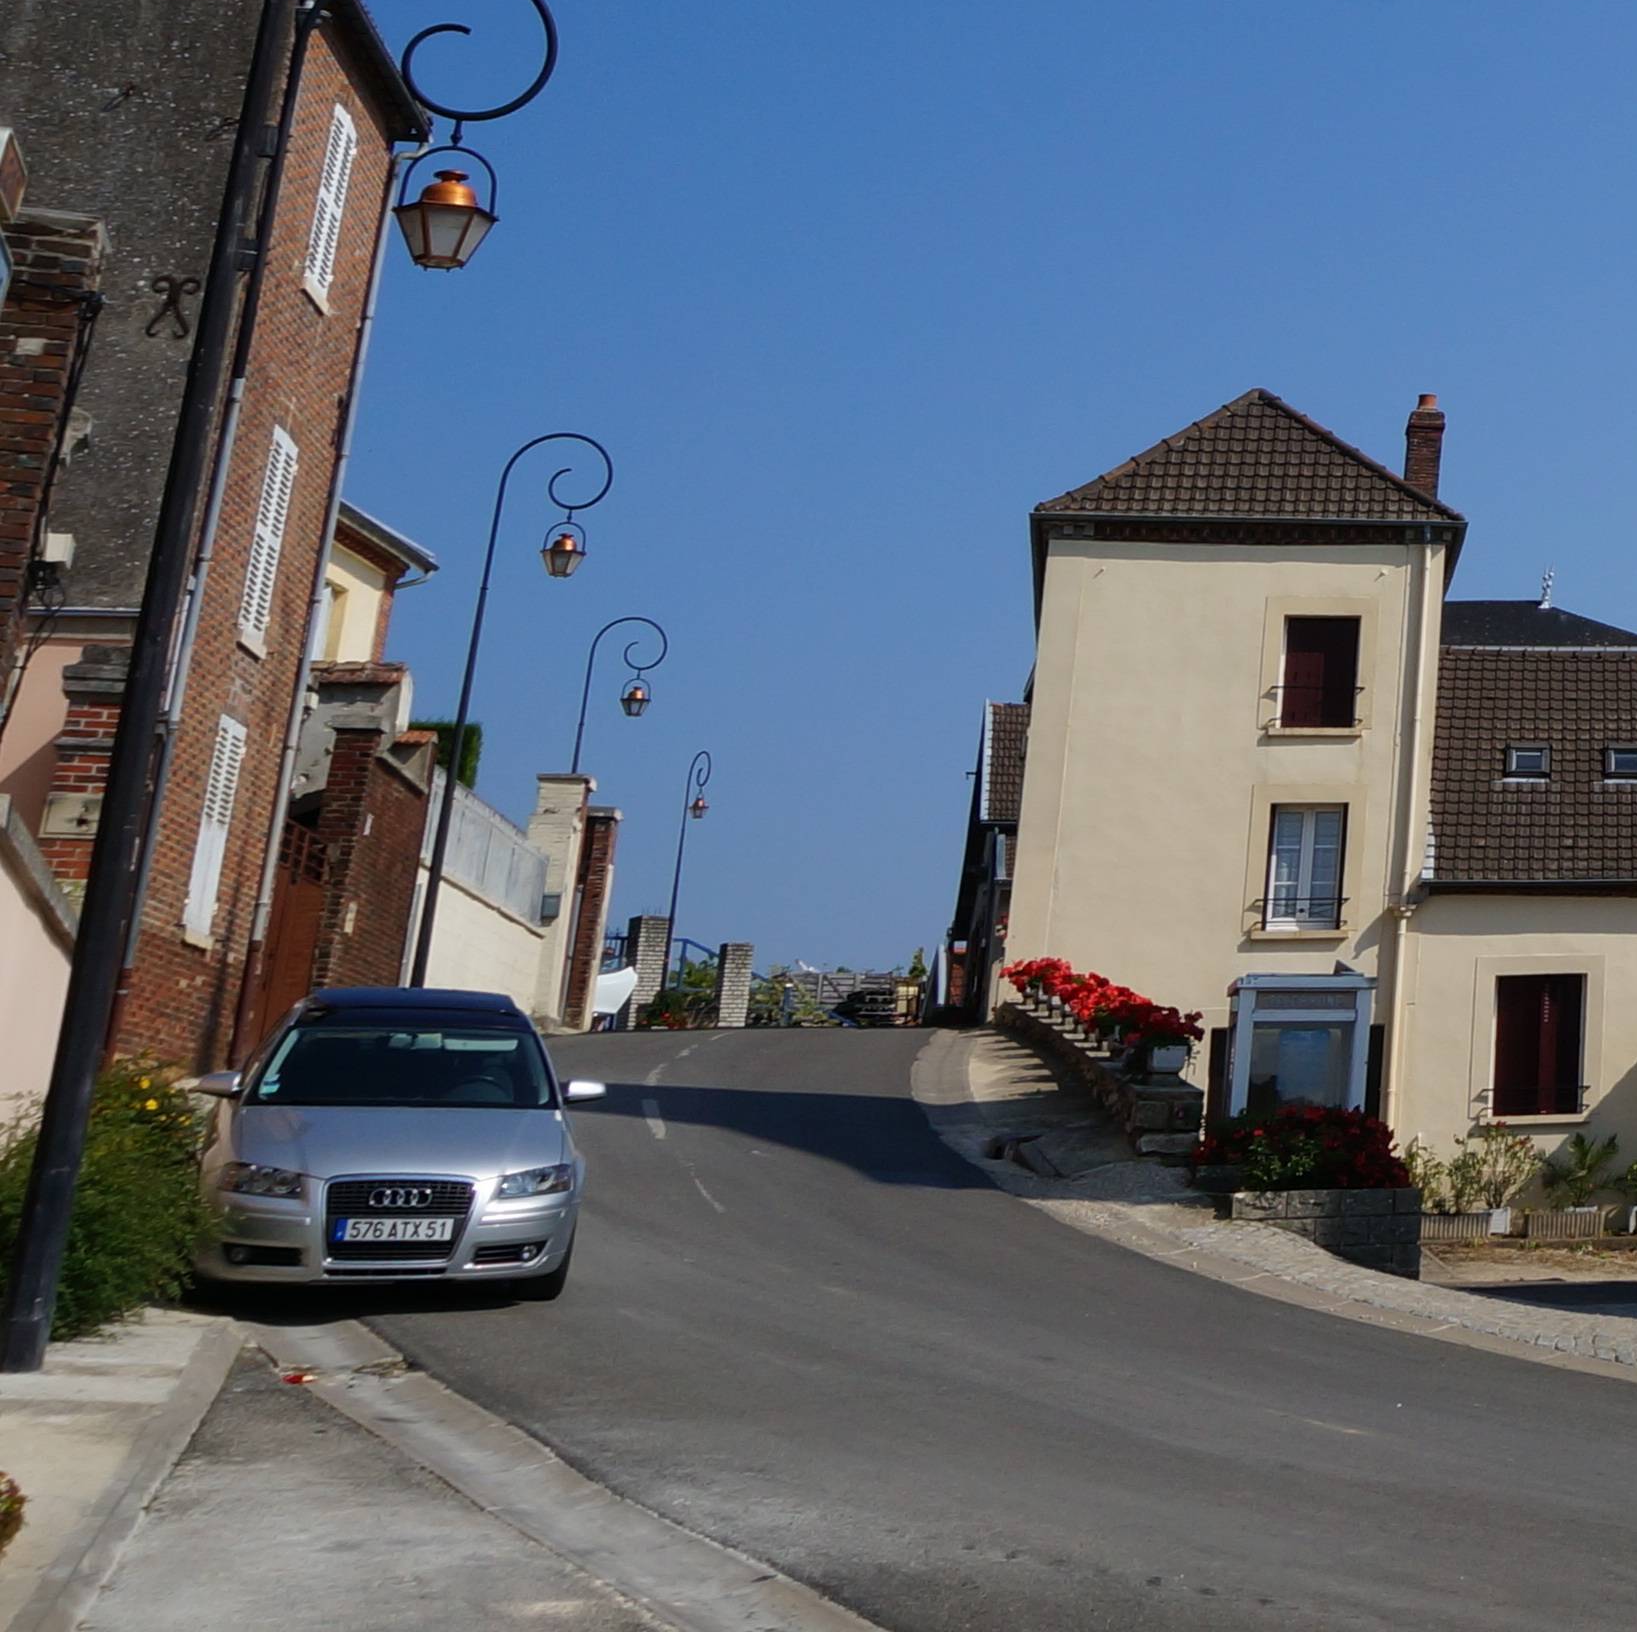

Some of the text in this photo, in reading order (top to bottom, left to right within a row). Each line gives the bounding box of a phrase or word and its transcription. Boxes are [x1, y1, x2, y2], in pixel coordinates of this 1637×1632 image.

[349, 1221, 447, 1239] 576 ATX 51
